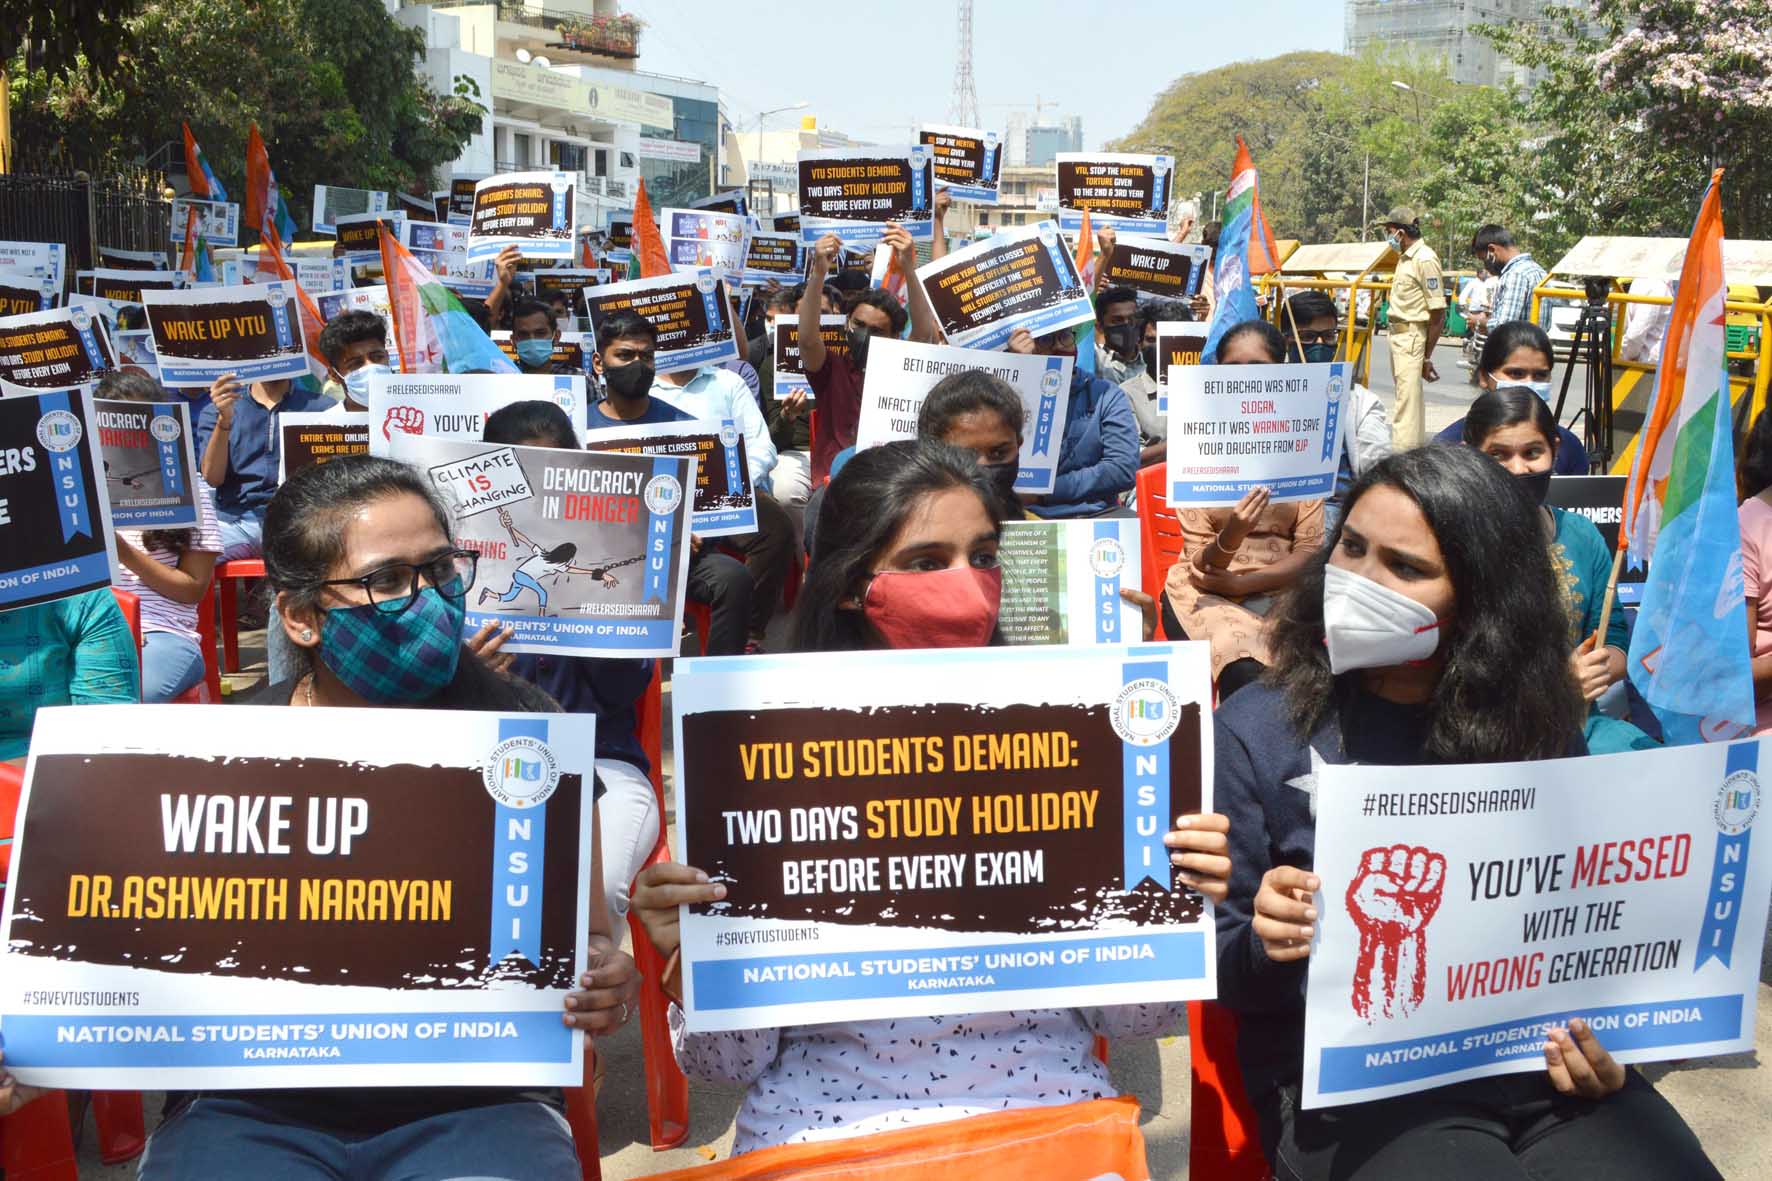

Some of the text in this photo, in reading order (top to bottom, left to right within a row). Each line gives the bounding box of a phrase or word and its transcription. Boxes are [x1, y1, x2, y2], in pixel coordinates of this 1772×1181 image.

[812, 168, 826, 179] VTU
[827, 166, 865, 178] STUDENTS
[867, 165, 901, 177] DEMAND:
[1090, 166, 1144, 176] STOP THE MENTAL
[808, 182, 906, 198] TWO DAYS STUDY HOLIDAY
[1086, 177, 1132, 186] TORTURE GIVEN
[1074, 188, 1144, 198] TO THE 2ND 3RD YEAR
[496, 202, 548, 216] STUDY HOLIDAY
[822, 198, 892, 210] BEFORE EVERY EXAM
[1112, 200, 1142, 209] STUDENTS
[500, 216, 534, 228] EVERY EXAM
[939, 244, 1039, 288] ENTIRE YEAR ONLINE CLASSES THEN
[1130, 254, 1170, 270] WAKE UP
[952, 256, 1036, 294] EXAMS ARE OFFLINE WITHOUT
[960, 268, 1036, 302] ANY SUFFICIENT TIME HOW
[616, 290, 692, 310] YEAR ONLINE CLASSES THEN
[960, 276, 1044, 314] WILL STUDENTS PREPARE THE
[638, 300, 688, 315] OFFLINE WITHOUT
[970, 288, 1042, 321] TECHNICAL SUBJECTS???
[656, 314, 670, 322] TIME
[670, 311, 685, 320] HOW
[680, 320, 691, 328] THE
[162, 314, 268, 340] WAKE UP VTU
[8, 329, 68, 348] STUDENTS DEMAND:
[22, 344, 80, 364] STUDY HOLIDAY
[784, 346, 800, 357] TWO
[32, 362, 72, 378] EVERY EXAM
[904, 358, 923, 372] BETI
[386, 384, 462, 396] #RELEASEDISHARAVI
[1204, 378, 1308, 394] BETI BACHAO WAS NOT A
[878, 396, 912, 413] INFACT
[1241, 400, 1276, 414] SLOGAN,
[433, 414, 480, 432] YOU'VE
[890, 418, 916, 434] YOUR
[1184, 418, 1320, 435] INFACT IT WAS WARNING TO SAVE
[300, 434, 368, 442] ENTIRE YEAR ONLINE
[642, 440, 714, 454] ONLINE CLASSES THEN
[1198, 438, 1308, 456] YOUR DAUGHTER FROM BJP
[312, 445, 350, 454] EXAMS ARE
[163, 445, 176, 489] NSUI
[438, 452, 514, 484] CLIMATE
[468, 474, 492, 494] IS
[542, 466, 644, 494] DEMOCRACY
[58, 456, 78, 526] NSUI
[452, 483, 528, 514] CHANGING
[542, 494, 640, 524] IN DANGER
[652, 520, 667, 588] NSUI
[22, 564, 80, 584] OF INDIA
[580, 602, 660, 616] #RELEASEDISHARAVI
[553, 623, 649, 636] UNION OF INDIA
[739, 731, 1079, 781] VTU STUDENTS DEMAND:
[1135, 754, 1157, 866] NSUI
[1362, 787, 1536, 816] #RELEASEDISHARAVI
[160, 794, 368, 856] WAKE UP
[722, 790, 1100, 846] TWO DAYS STUDY HOLIDAY
[782, 849, 1044, 896] BEFORE EVERY EXAM
[1468, 833, 1692, 901] YOU'VE MESSED
[506, 818, 532, 940] NSUI
[67, 875, 452, 921] DR.ASHWATH NARAYAN
[1712, 842, 1740, 947] NSUI
[1522, 900, 1625, 943] WITH THE
[716, 928, 820, 946] #SAVEVTUSTUDENTS
[743, 942, 1156, 984] NATIONAL STUDENTS' UNION OF INDIA
[1446, 938, 1682, 1002] WRONG GENERATION
[908, 974, 996, 990] KARNATAKA
[24, 991, 140, 1006] #SAVEVTUSTUDENTS
[57, 1022, 518, 1044] NATIONAL STUDENTS' UNION OF INDIA
[1365, 1008, 1703, 1068] NATIONAL OF INDIA
[243, 1047, 340, 1059] KARNATAKA
